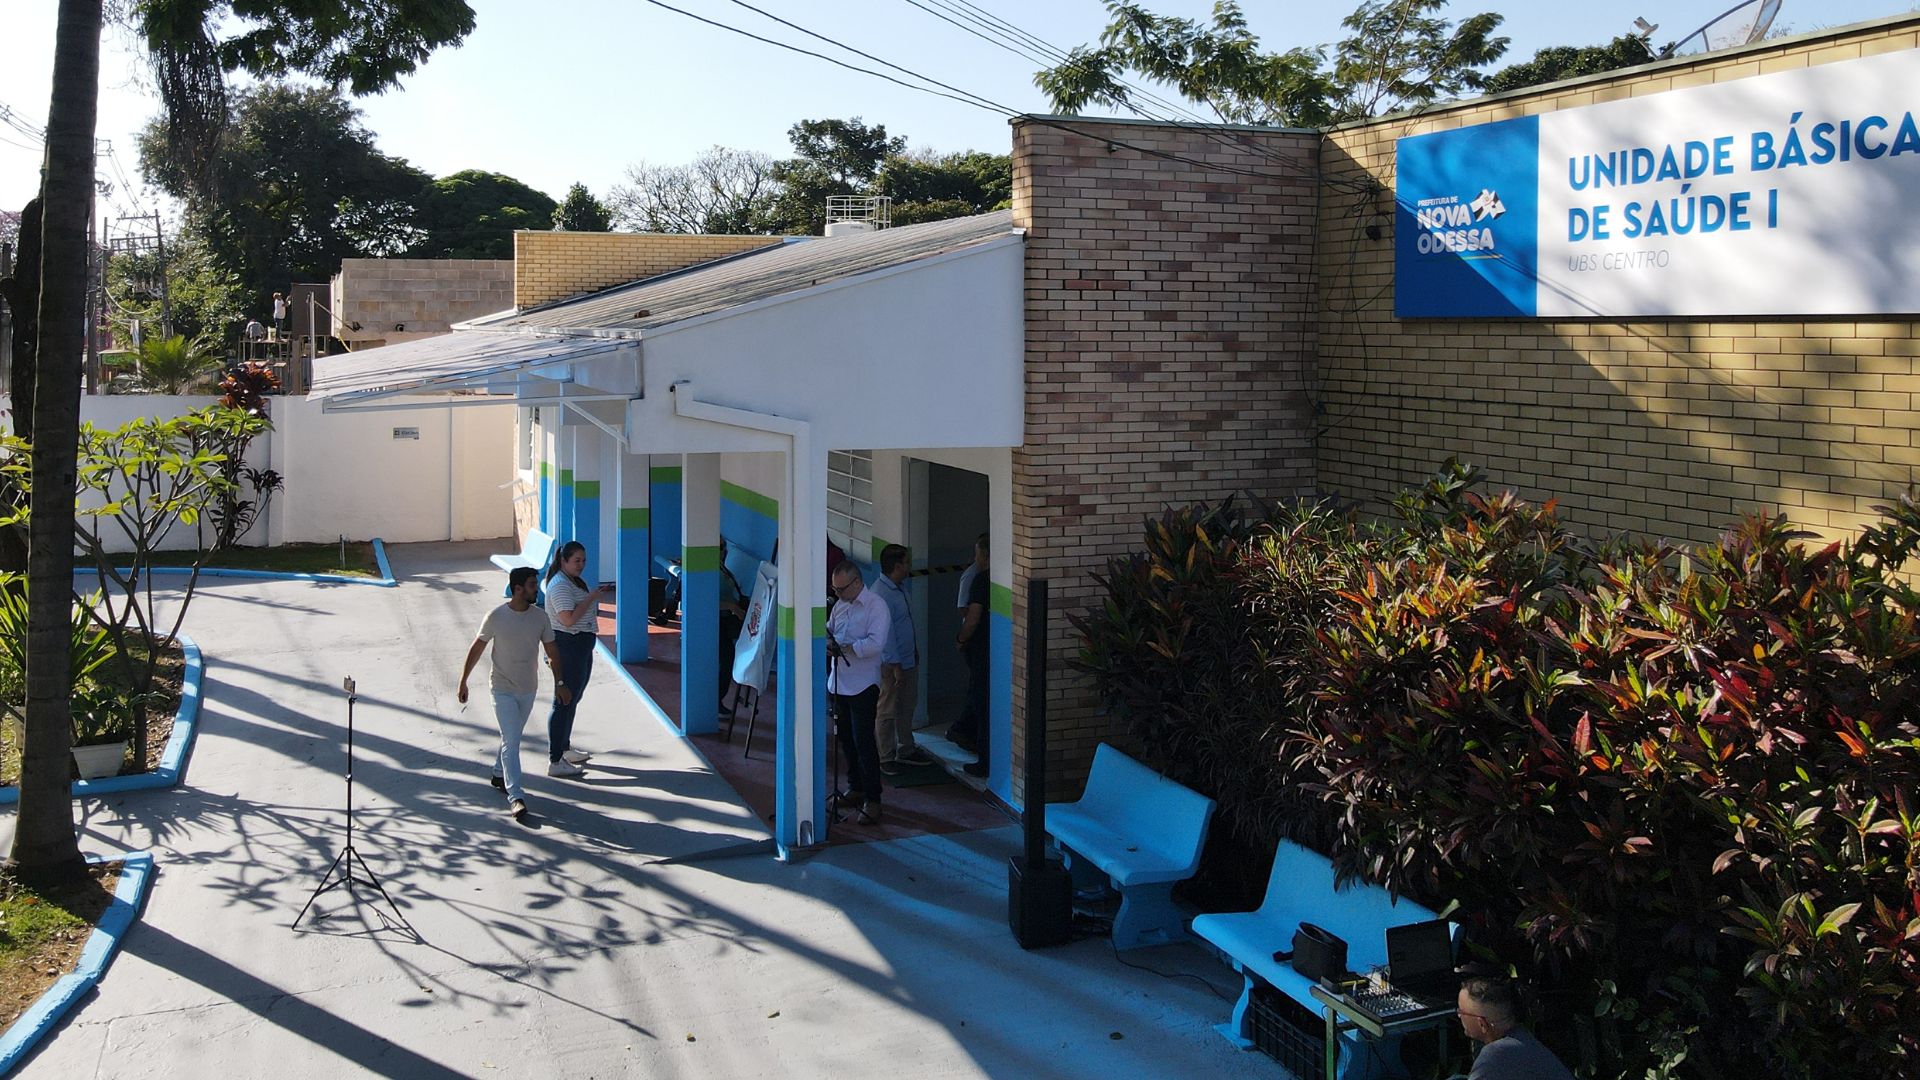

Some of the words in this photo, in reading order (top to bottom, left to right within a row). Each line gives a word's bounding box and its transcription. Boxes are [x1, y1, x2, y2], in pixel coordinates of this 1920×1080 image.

[1569, 136, 1734, 191] UNIDADE
[1751, 111, 1920, 172] BÁSICA
[1417, 198, 1449, 207] PREFEITURA
[1450, 196, 1458, 204] DE
[1568, 205, 1610, 242] DE
[1623, 183, 1750, 239] SAÚDE
[1768, 189, 1777, 228] I
[1417, 204, 1471, 230] NOVA
[1417, 228, 1494, 255] ODESSA
[1568, 254, 1598, 272] UBS
[1602, 249, 1670, 271] CENTRO
